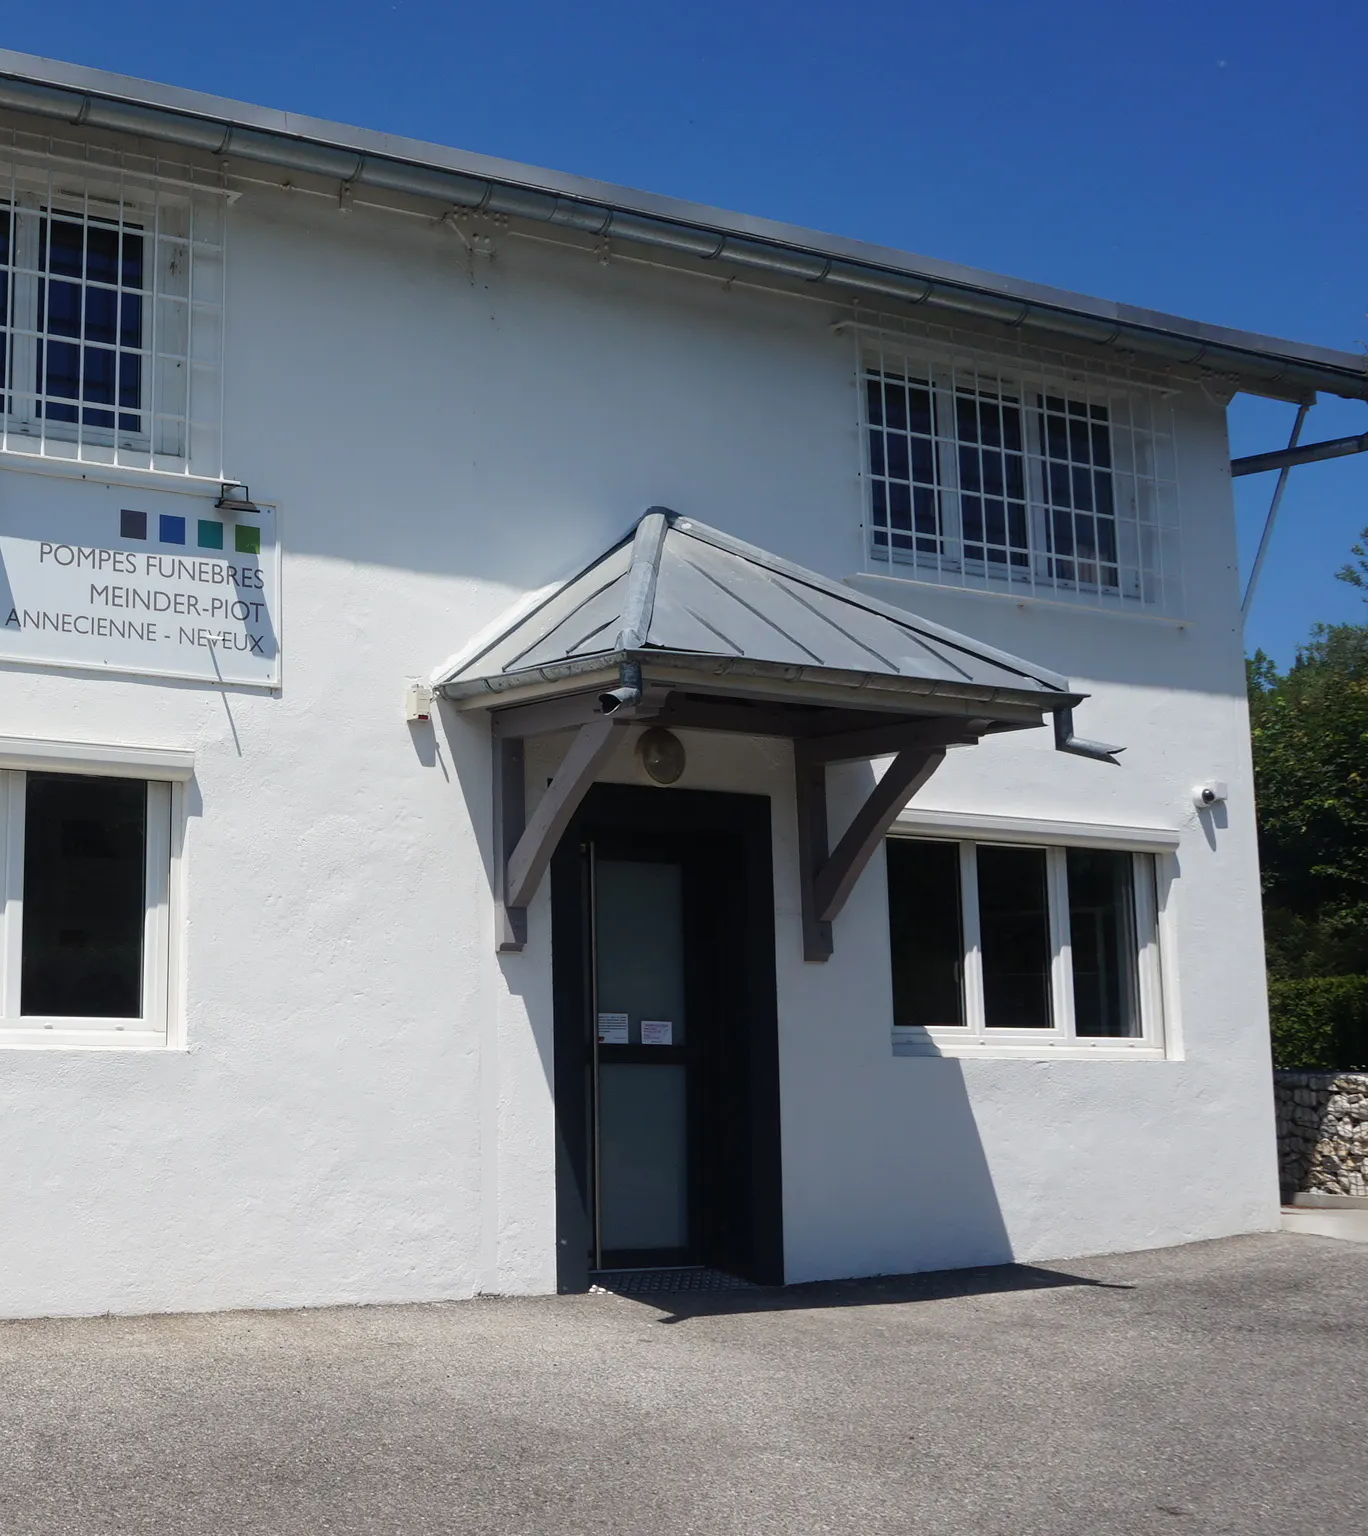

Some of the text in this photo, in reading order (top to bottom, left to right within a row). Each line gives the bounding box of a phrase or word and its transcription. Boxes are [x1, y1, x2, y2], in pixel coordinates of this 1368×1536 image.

[39, 542, 265, 590] POMPES FUNEBRES
[90, 583, 265, 623] MEINDER-PIOT
[5, 607, 157, 642] ANNECIENNE
[179, 626, 265, 654] NEVEUX
